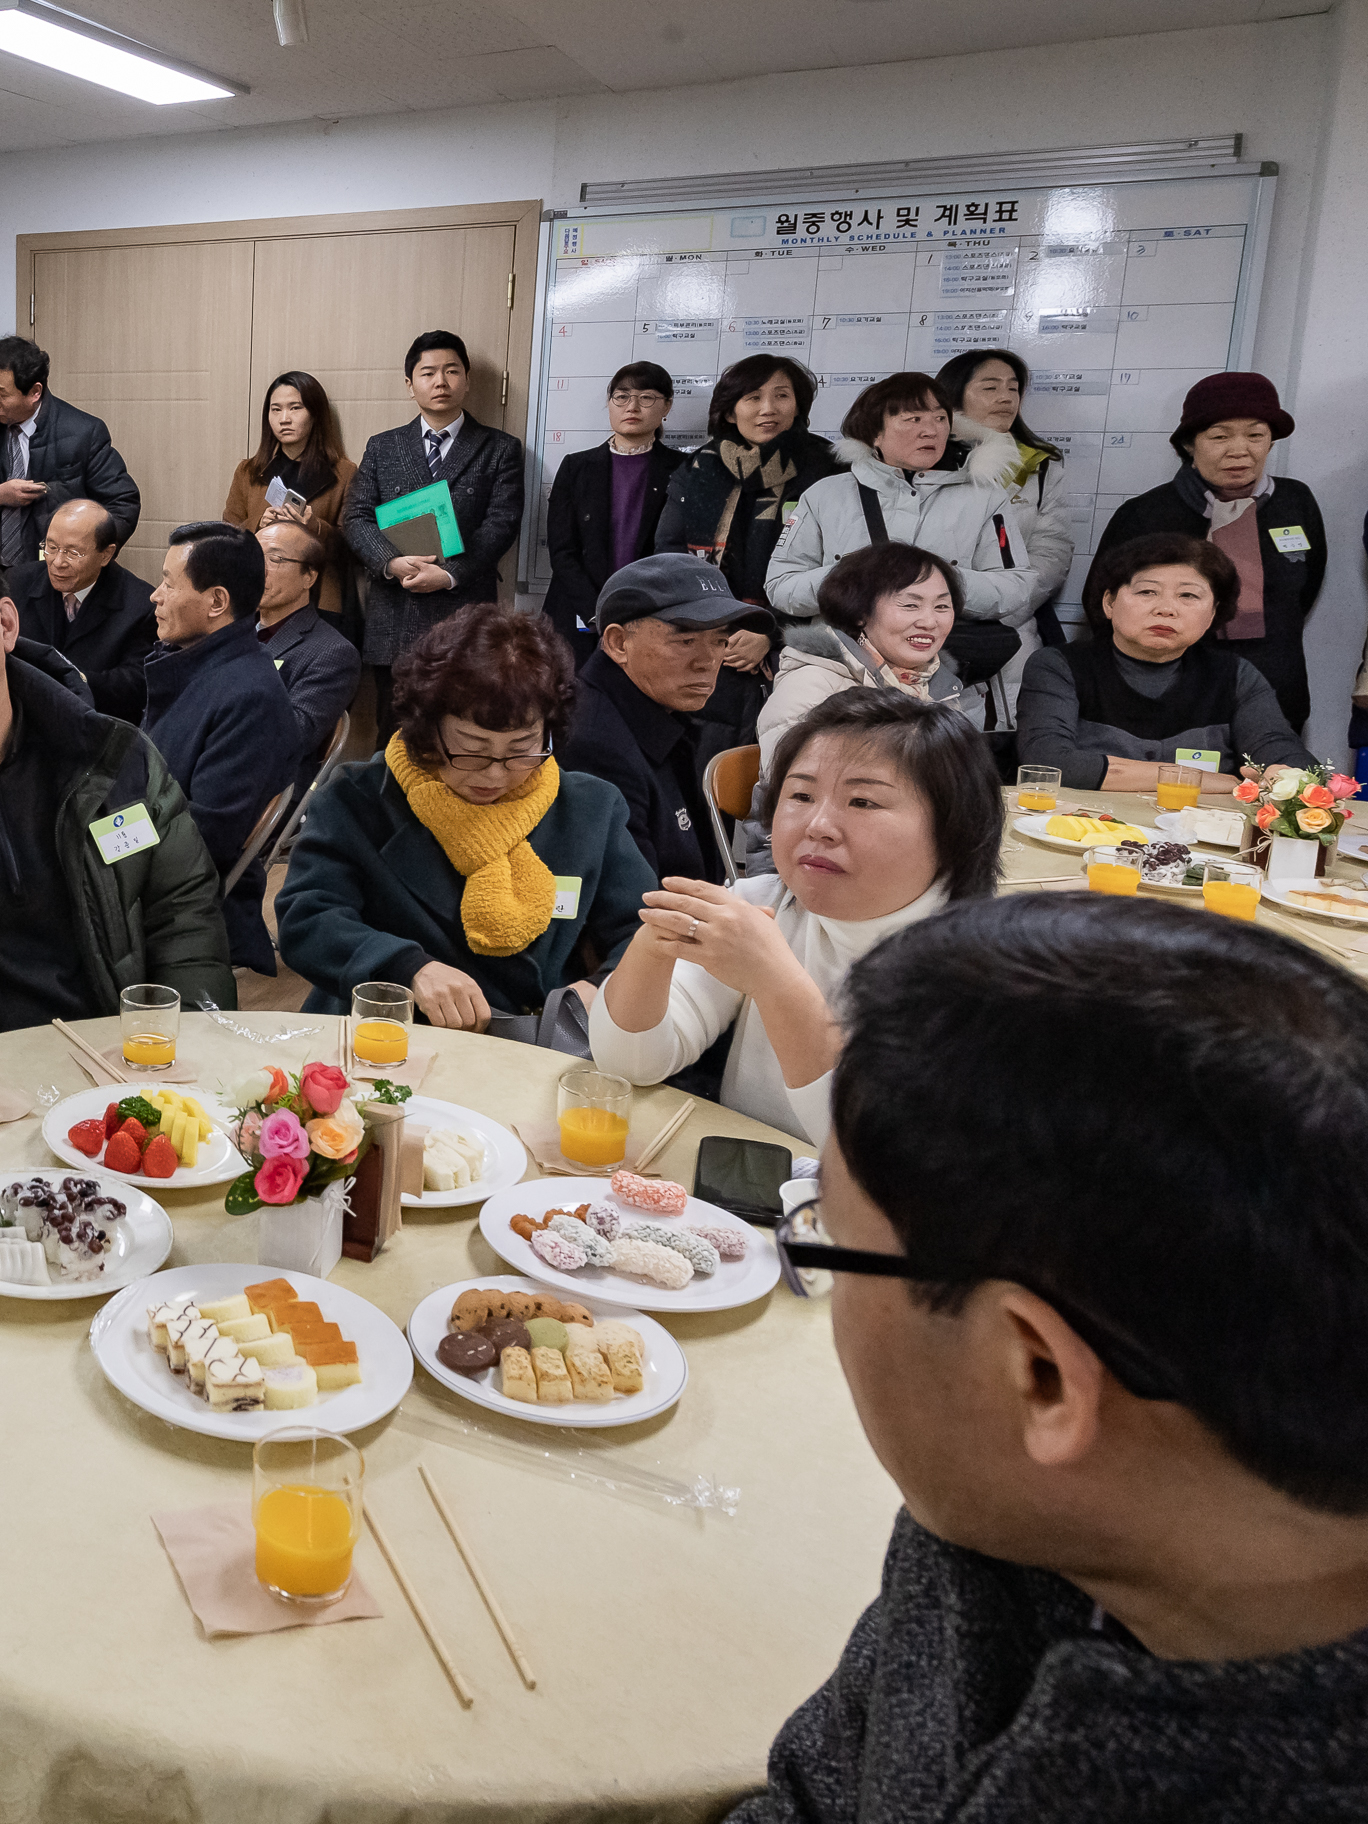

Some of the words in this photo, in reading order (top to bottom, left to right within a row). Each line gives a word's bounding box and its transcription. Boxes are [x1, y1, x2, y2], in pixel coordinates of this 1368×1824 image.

[775, 209, 884, 235] 월중행사
[895, 206, 920, 229] 및
[933, 200, 1019, 227] 계획표
[781, 236, 840, 245] MONTHLY
[848, 231, 917, 242] SCHEDULE
[943, 227, 1006, 237] PLANNER
[822, 317, 831, 330] 7
[919, 314, 927, 325] 8
[642, 323, 650, 333] 5
